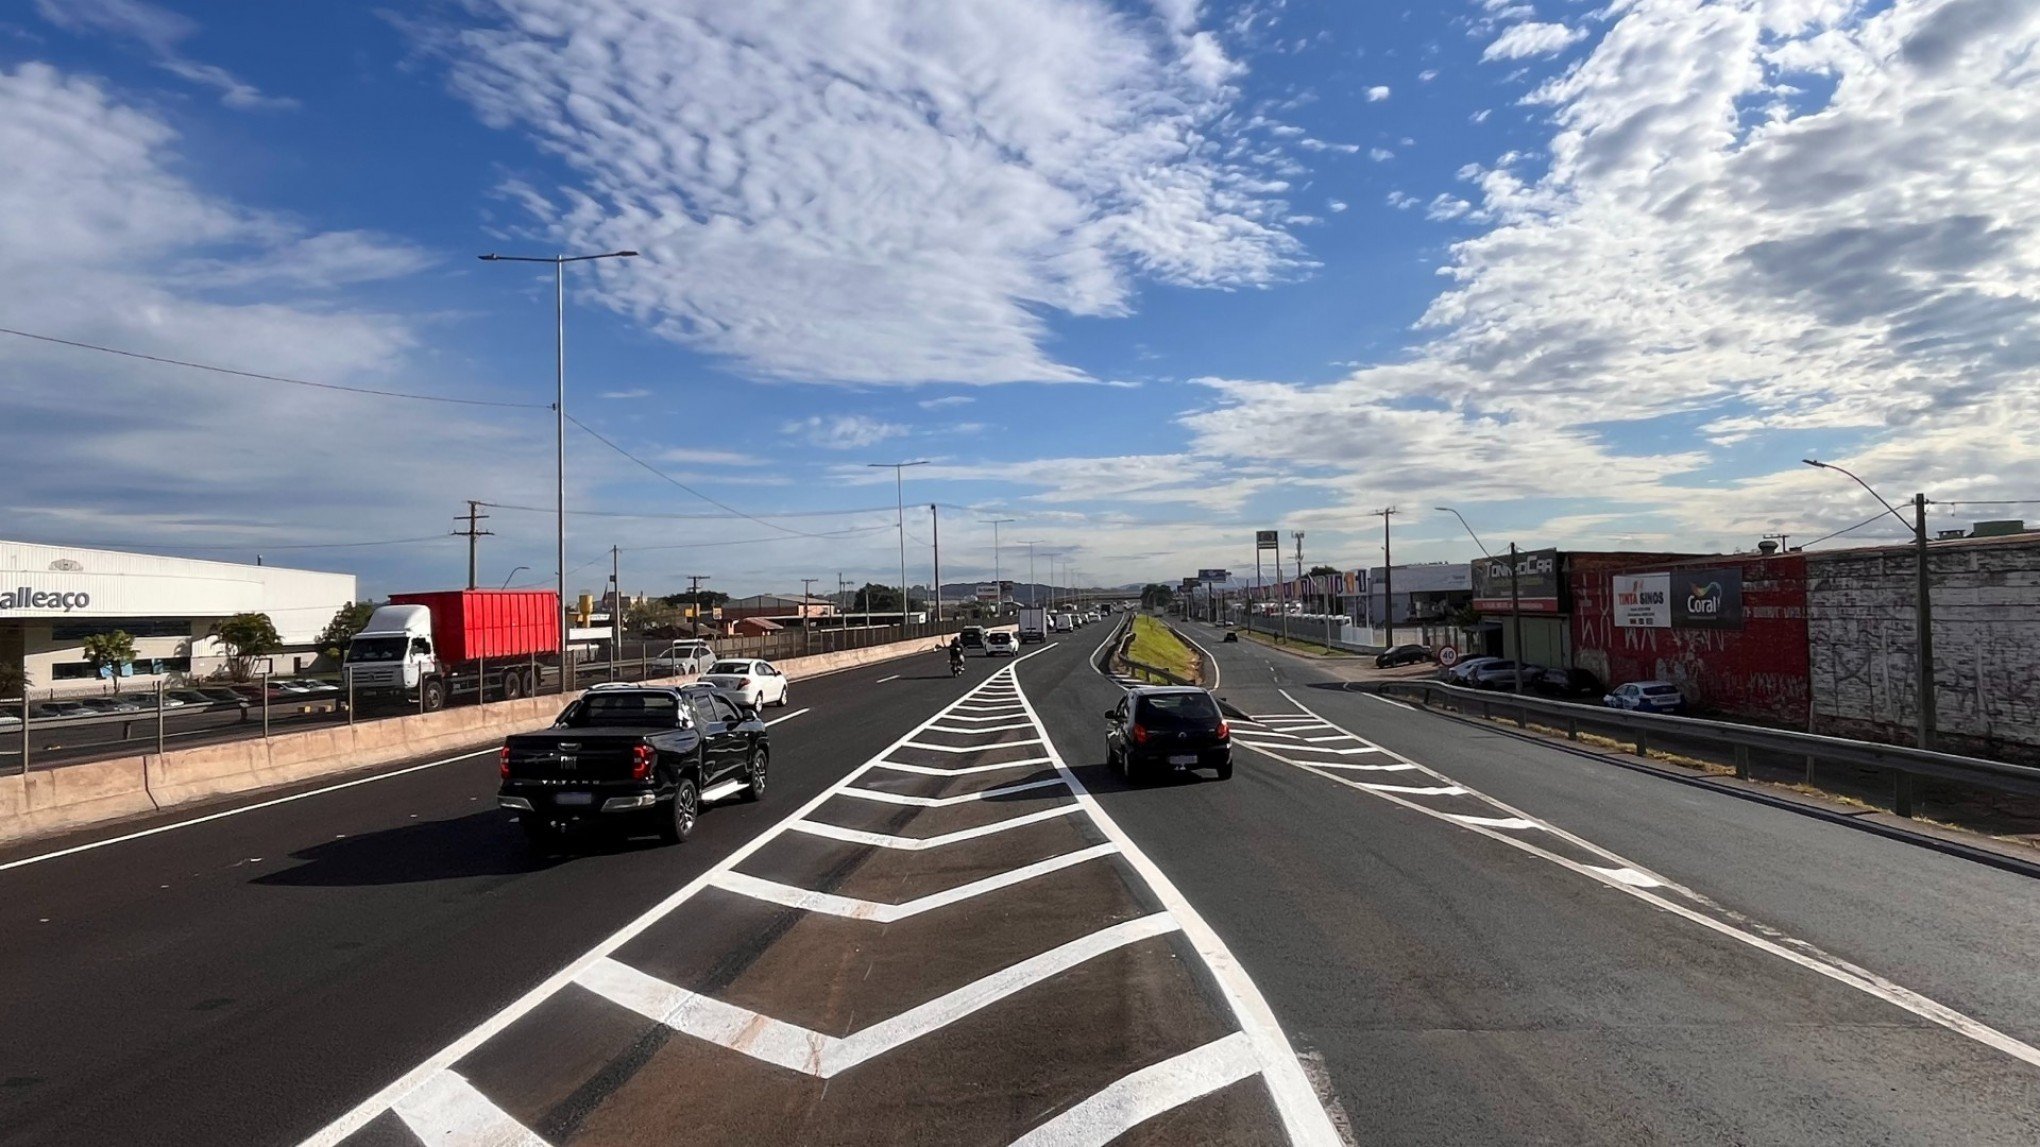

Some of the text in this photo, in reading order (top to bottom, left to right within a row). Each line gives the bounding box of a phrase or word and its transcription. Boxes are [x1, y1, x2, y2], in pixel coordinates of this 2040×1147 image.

[0, 586, 90, 613] alleaço
[1618, 591, 1665, 606] TINTA SINOS
[1687, 595, 1717, 613] Coral
[1443, 650, 1455, 660] 40
